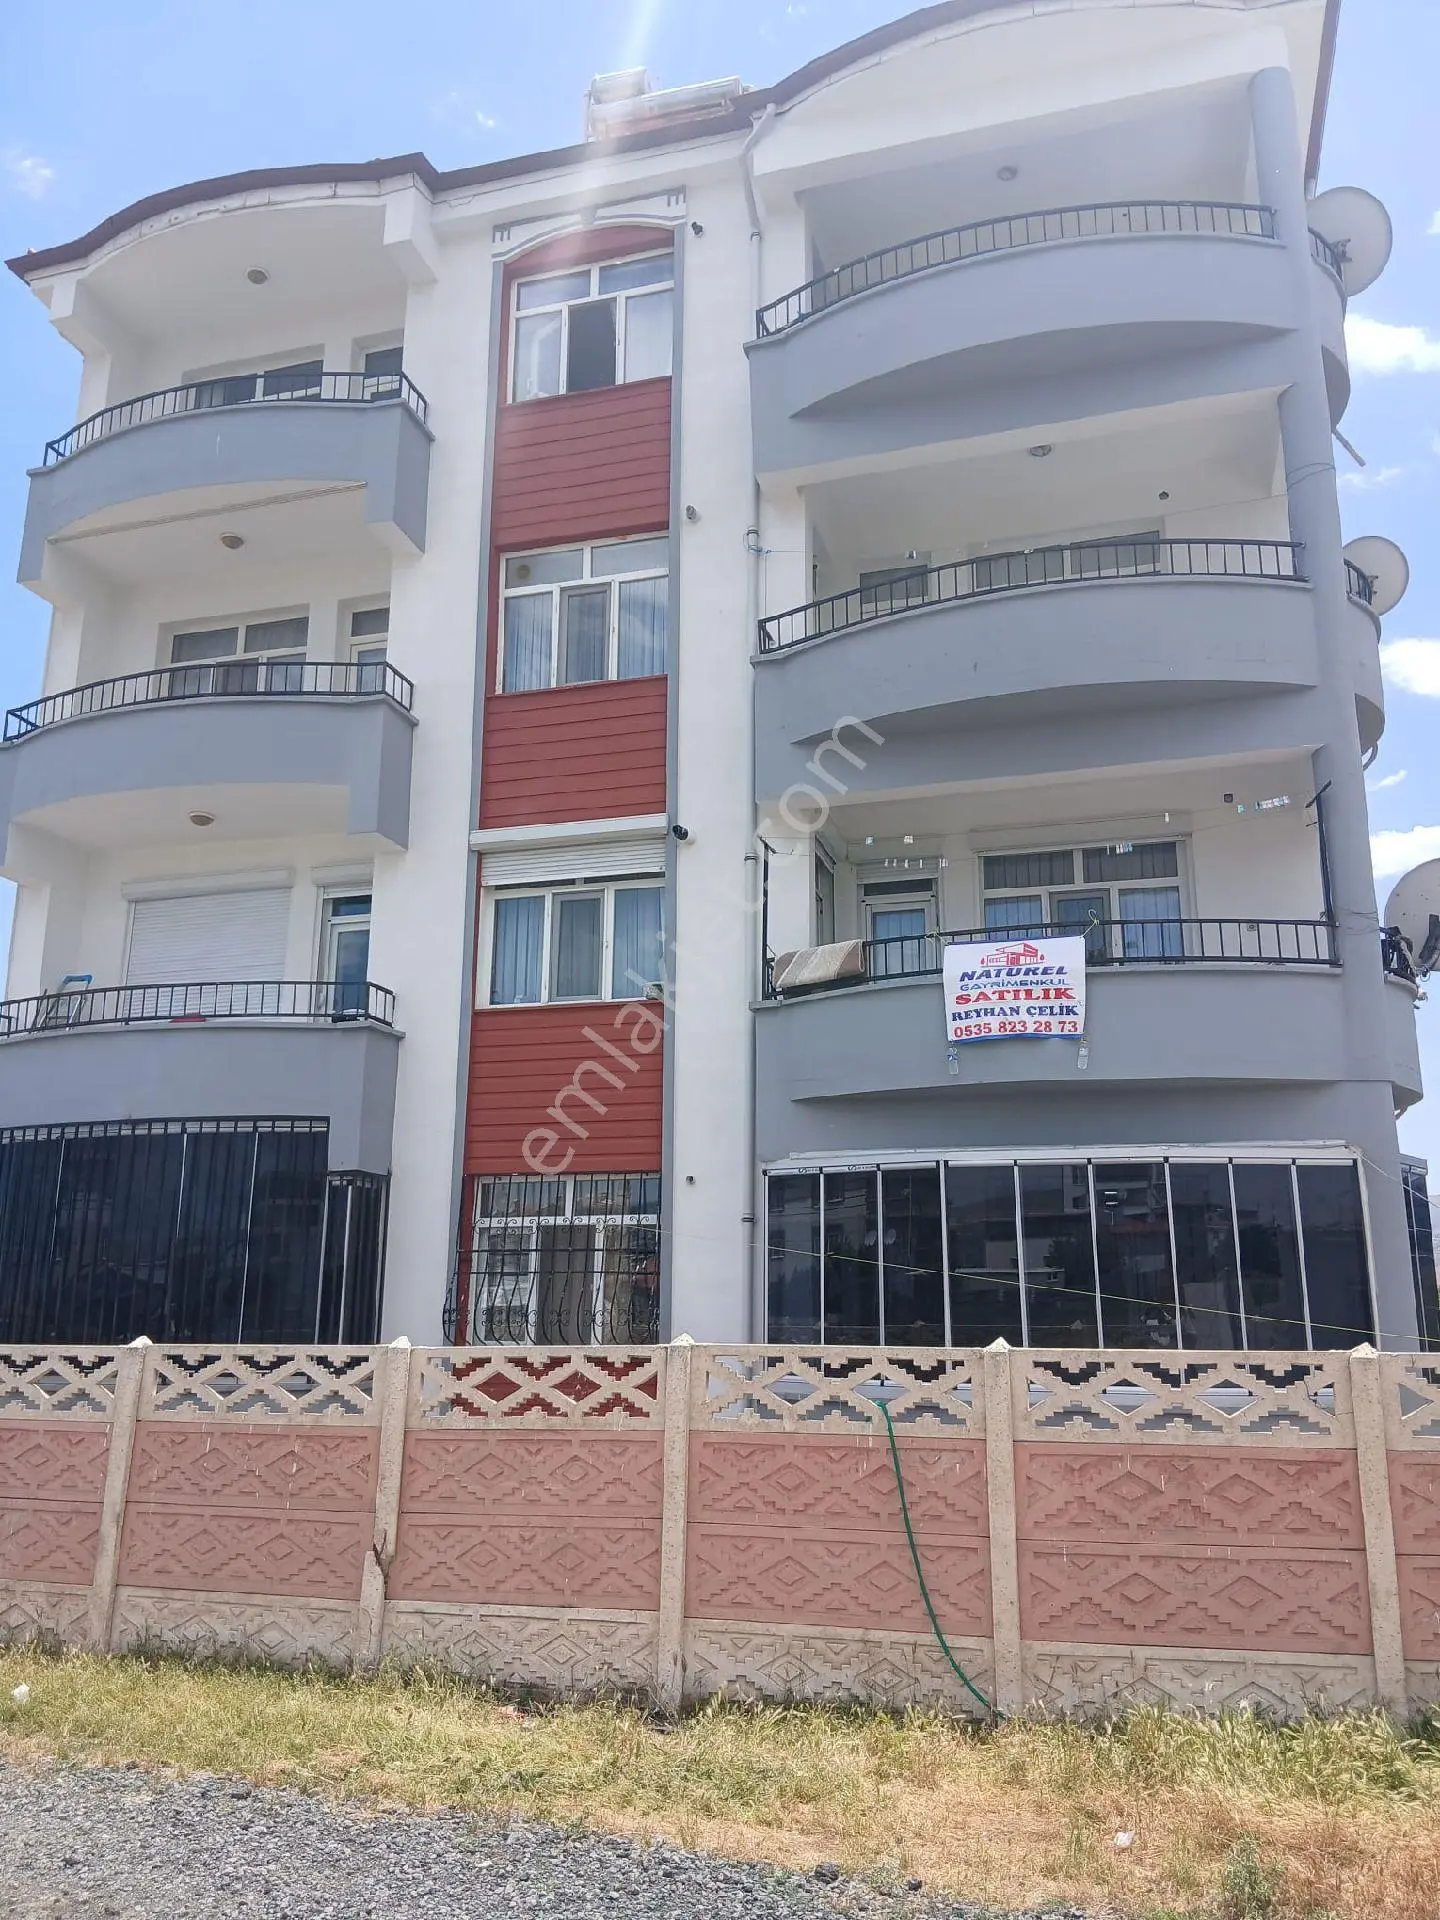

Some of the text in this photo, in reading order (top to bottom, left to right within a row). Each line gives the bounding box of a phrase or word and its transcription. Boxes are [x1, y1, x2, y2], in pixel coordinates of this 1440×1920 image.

[960, 966, 1068, 981] NATUREL
[960, 979, 1070, 991] GAYRİMENKUL
[955, 988, 1075, 1005] SATILIK
[952, 1003, 1079, 1021] REYHAN ÇELİK
[954, 1021, 1078, 1038] 0535 823 28 73
